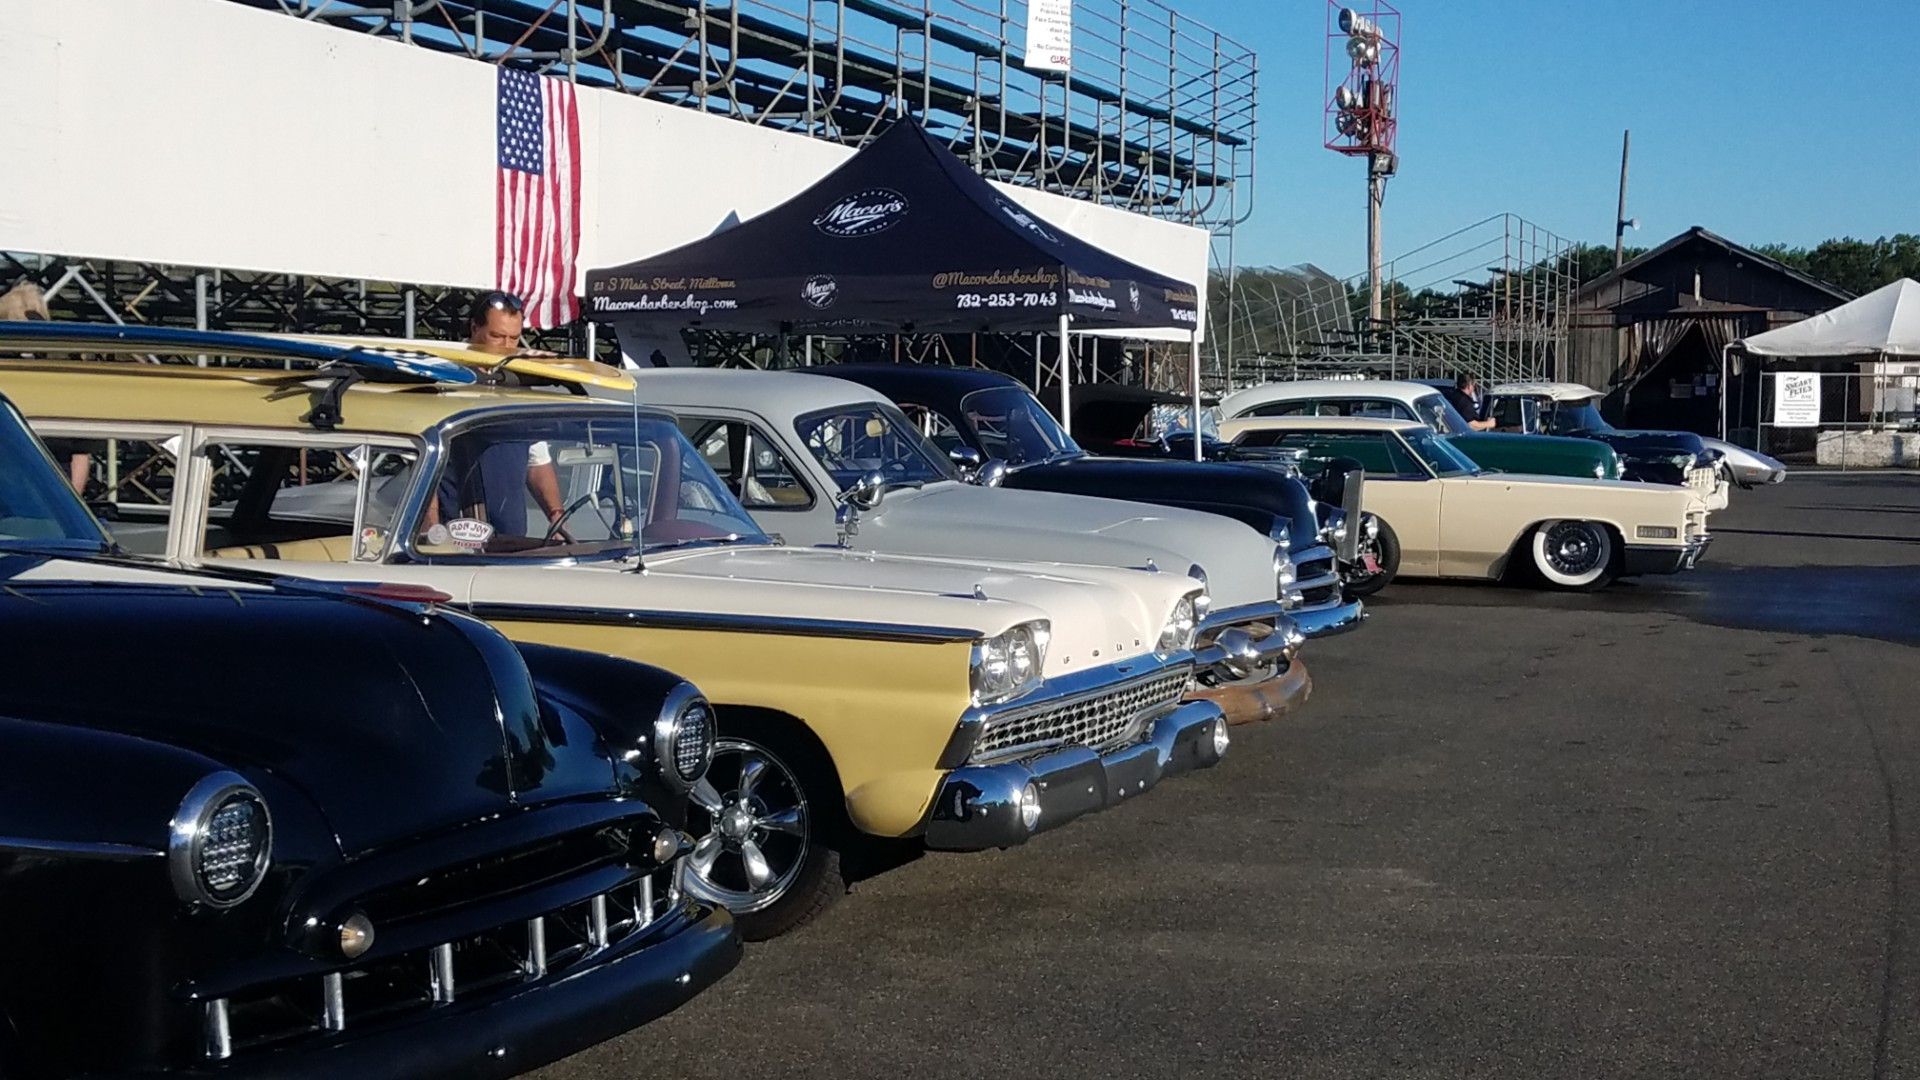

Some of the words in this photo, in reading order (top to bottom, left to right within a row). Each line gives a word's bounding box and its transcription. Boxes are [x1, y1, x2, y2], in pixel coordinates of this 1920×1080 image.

[812, 199, 904, 226] Macor's
[608, 277, 618, 291] S
[619, 277, 648, 291] Main
[932, 267, 1059, 289] @Macorsbarbershop
[592, 294, 738, 315] Macorsbarbershop.com
[956, 291, 1058, 309] 732-253-7043
